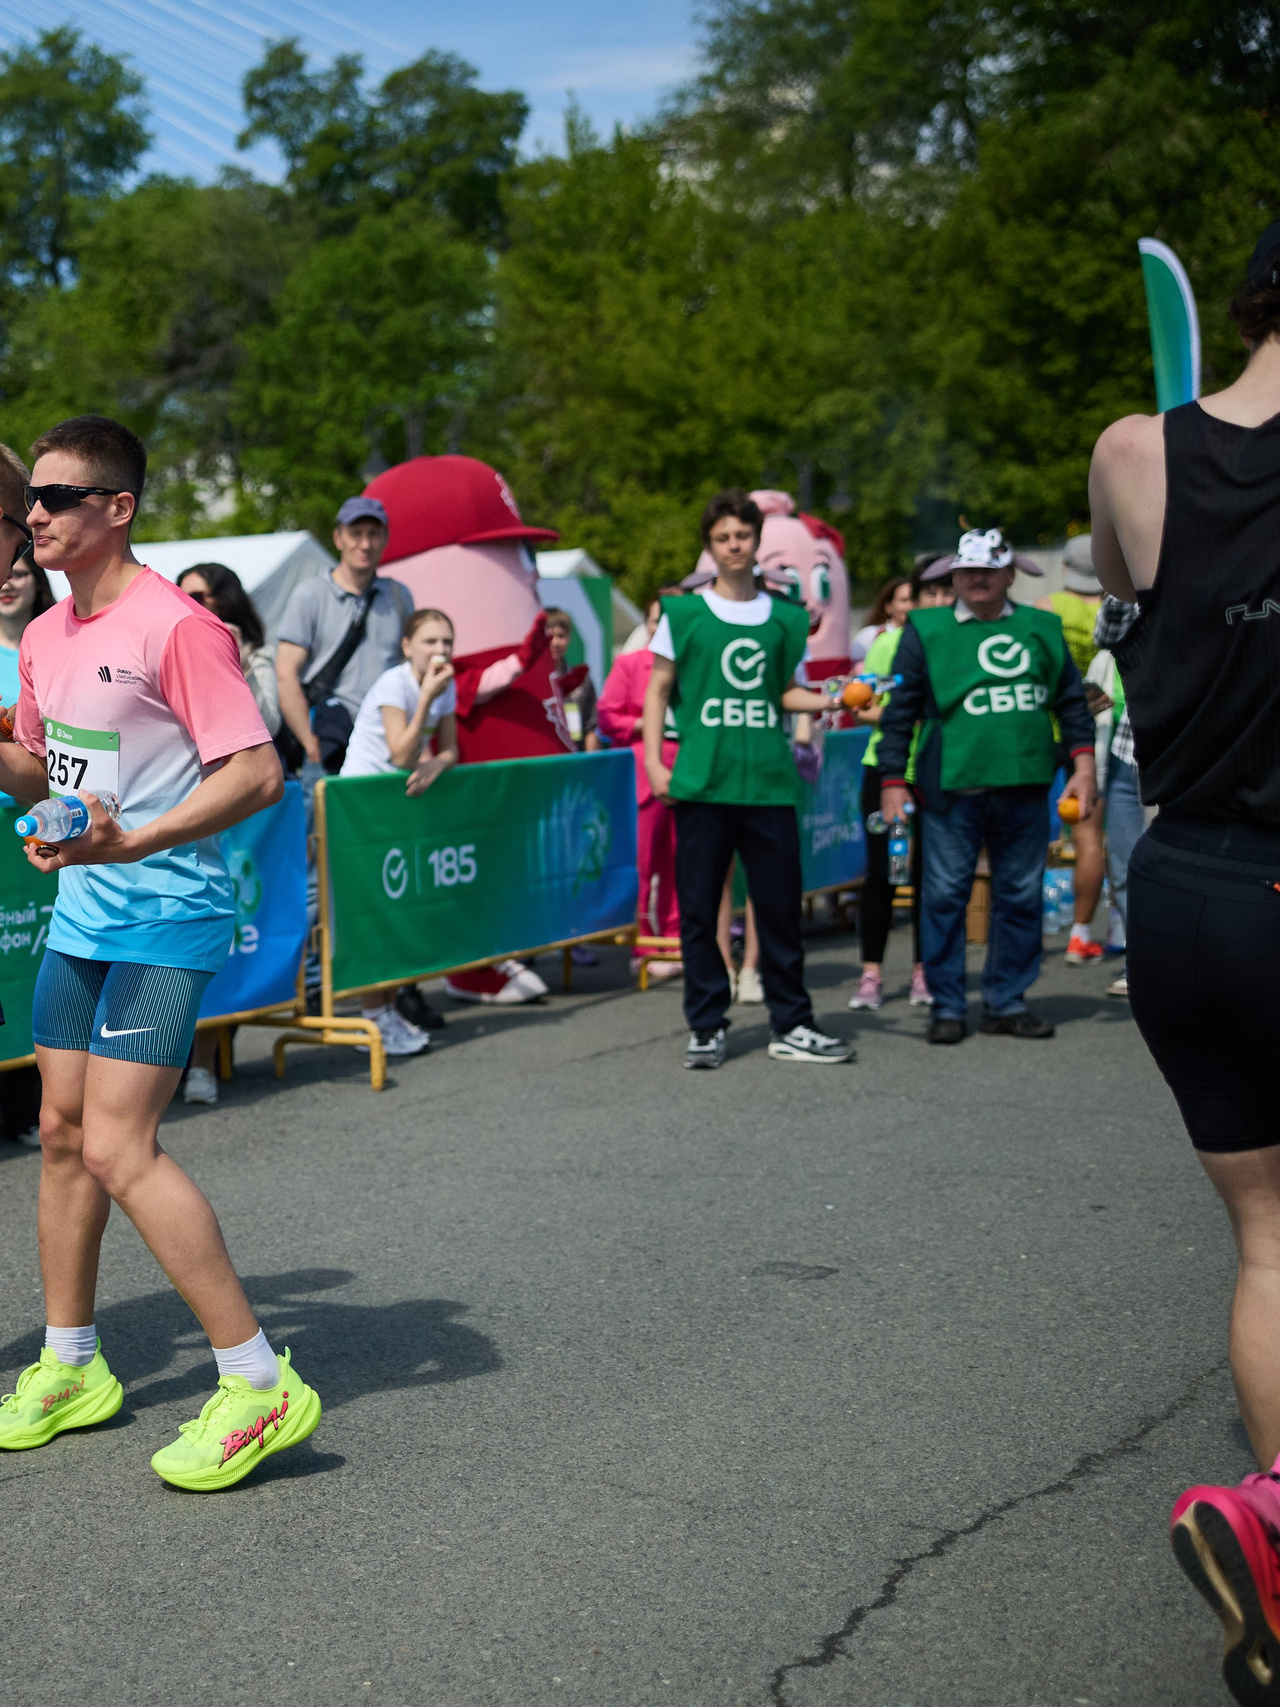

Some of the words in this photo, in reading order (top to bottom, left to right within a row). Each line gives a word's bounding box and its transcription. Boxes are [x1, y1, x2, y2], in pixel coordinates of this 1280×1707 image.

[963, 683, 1049, 715] СБЕР
[48, 749, 88, 790] 257
[428, 843, 477, 888] 185
